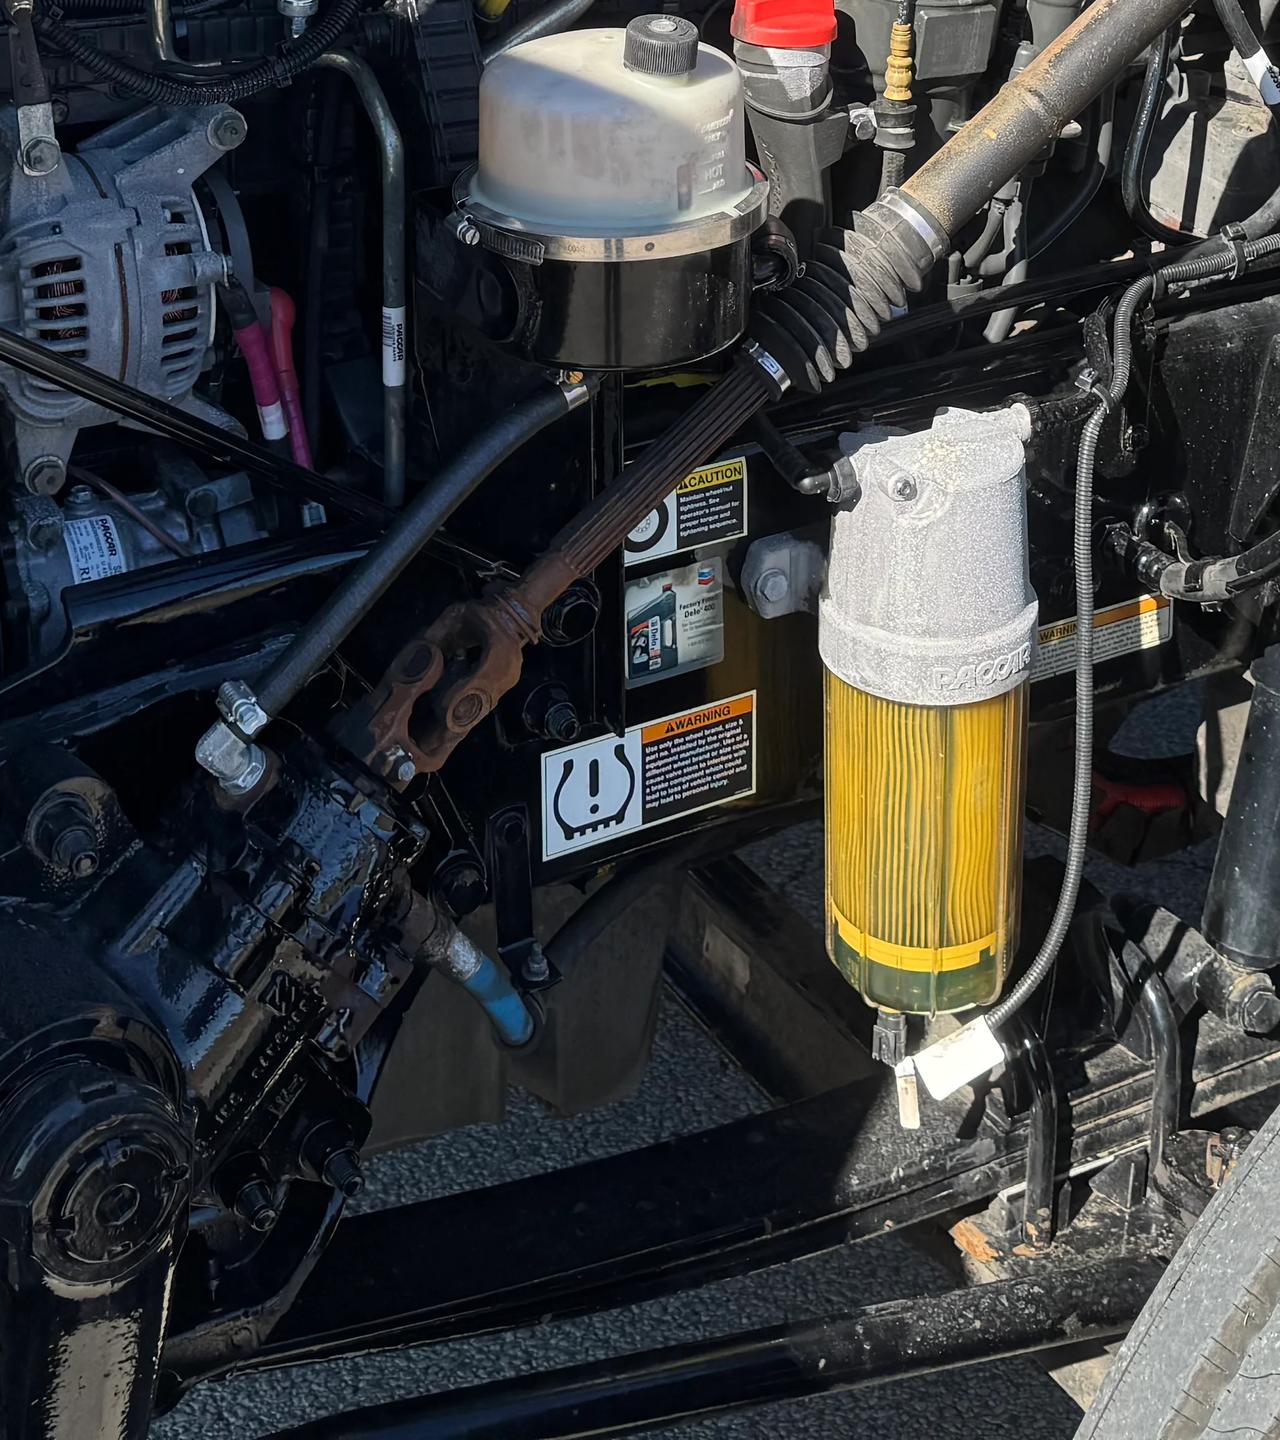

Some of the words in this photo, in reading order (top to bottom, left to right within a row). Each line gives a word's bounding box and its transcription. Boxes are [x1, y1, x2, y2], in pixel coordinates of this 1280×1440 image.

[689, 467, 742, 488] CAUTION
[710, 502, 731, 513] manual
[99, 518, 117, 557] PACCAR
[1040, 623, 1077, 641] WARNIN
[933, 642, 1031, 692] PACCAR
[675, 706, 731, 731] WARNING
[646, 746, 658, 754] Use
[660, 741, 673, 751] only
[686, 732, 704, 742] wheel
[705, 726, 724, 736] brand,
[725, 721, 738, 730] size
[646, 755, 659, 763] part
[660, 750, 670, 758] no.
[671, 742, 698, 754] installed
[719, 727, 742, 739] original
[646, 756, 679, 770] equipment
[680, 742, 722, 759] manufacturer.
[723, 738, 735, 746] Use
[646, 765, 672, 778] different
[673, 758, 692, 768] wheel
[692, 752, 711, 762] brand
[719, 746, 732, 754] size
[733, 740, 750, 750] could
[646, 776, 665, 786] cause
[666, 770, 683, 779] valve
[684, 765, 699, 774] stem
[707, 753, 733, 766] interfere
[734, 749, 747, 758] with
[651, 781, 669, 791] brake
[670, 771, 705, 788] component
[706, 765, 724, 774] which
[725, 758, 742, 769] could
[646, 792, 660, 801] lead
[668, 785, 682, 794] loss
[690, 776, 712, 787] vehicle
[713, 769, 735, 780] control
[736, 764, 748, 773] and
[646, 800, 660, 809] may
[661, 796, 674, 805] lead
[682, 784, 710, 799] personal
[710, 779, 729, 789] injury.
